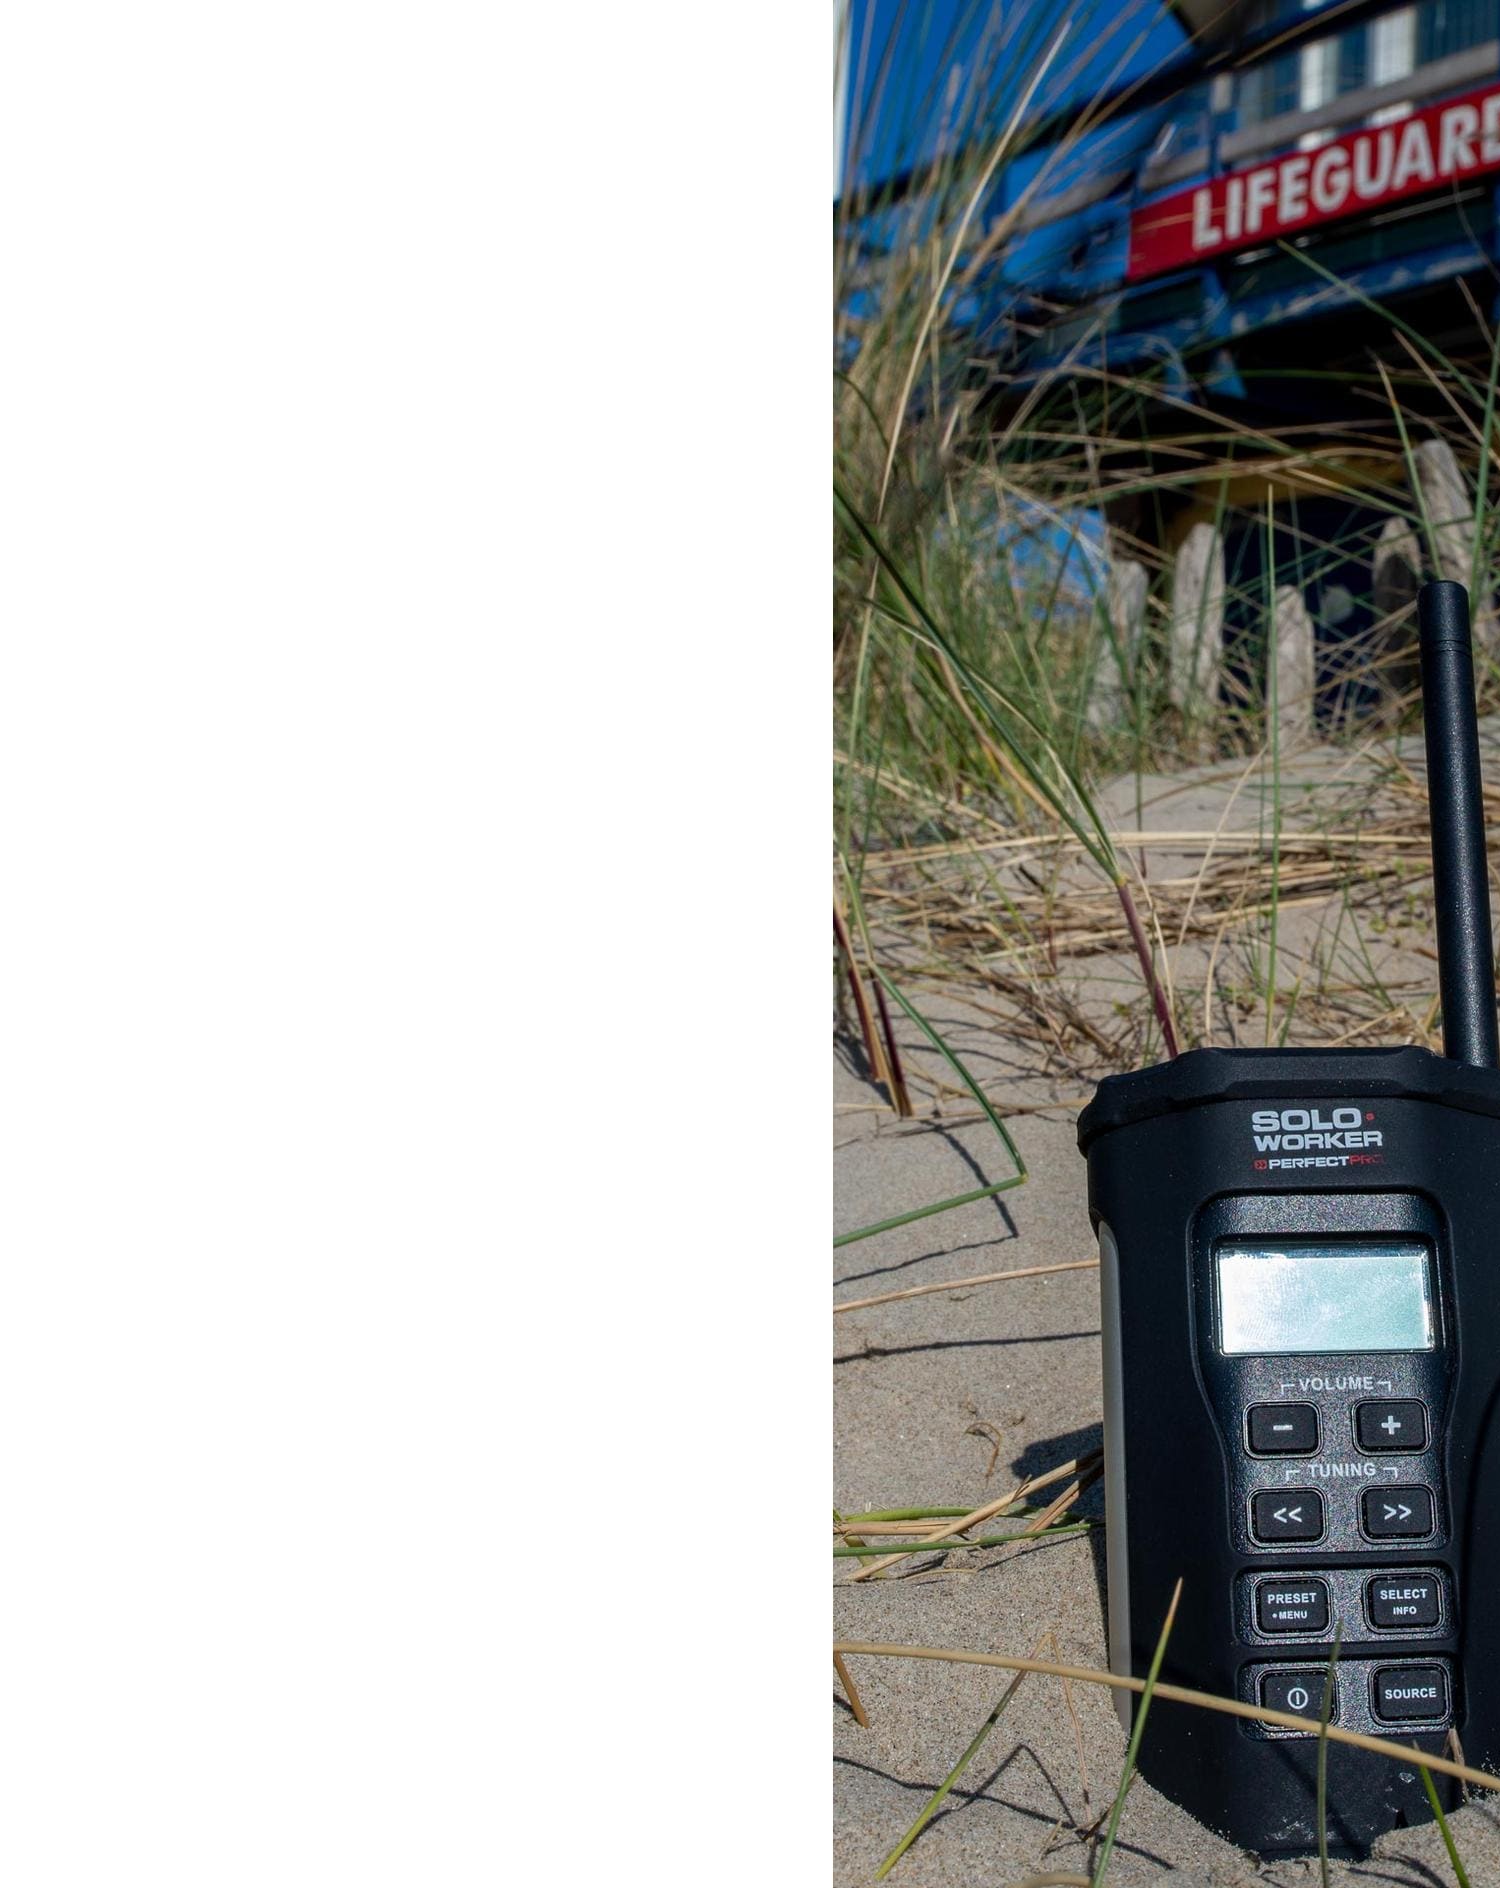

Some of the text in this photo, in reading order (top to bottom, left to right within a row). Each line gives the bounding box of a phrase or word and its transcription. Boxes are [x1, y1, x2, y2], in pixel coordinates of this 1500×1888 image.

[1252, 1108, 1362, 1132] SOLO
[1253, 1131, 1383, 1151] WORKER
[1299, 1376, 1374, 1391] VOLUME
[1307, 1462, 1376, 1477] TUNING
[1267, 1593, 1317, 1604] PRESET
[1380, 1588, 1428, 1600] SELECT
[1393, 1605, 1417, 1615] INFO
[1384, 1687, 1437, 1699] SOURCE
